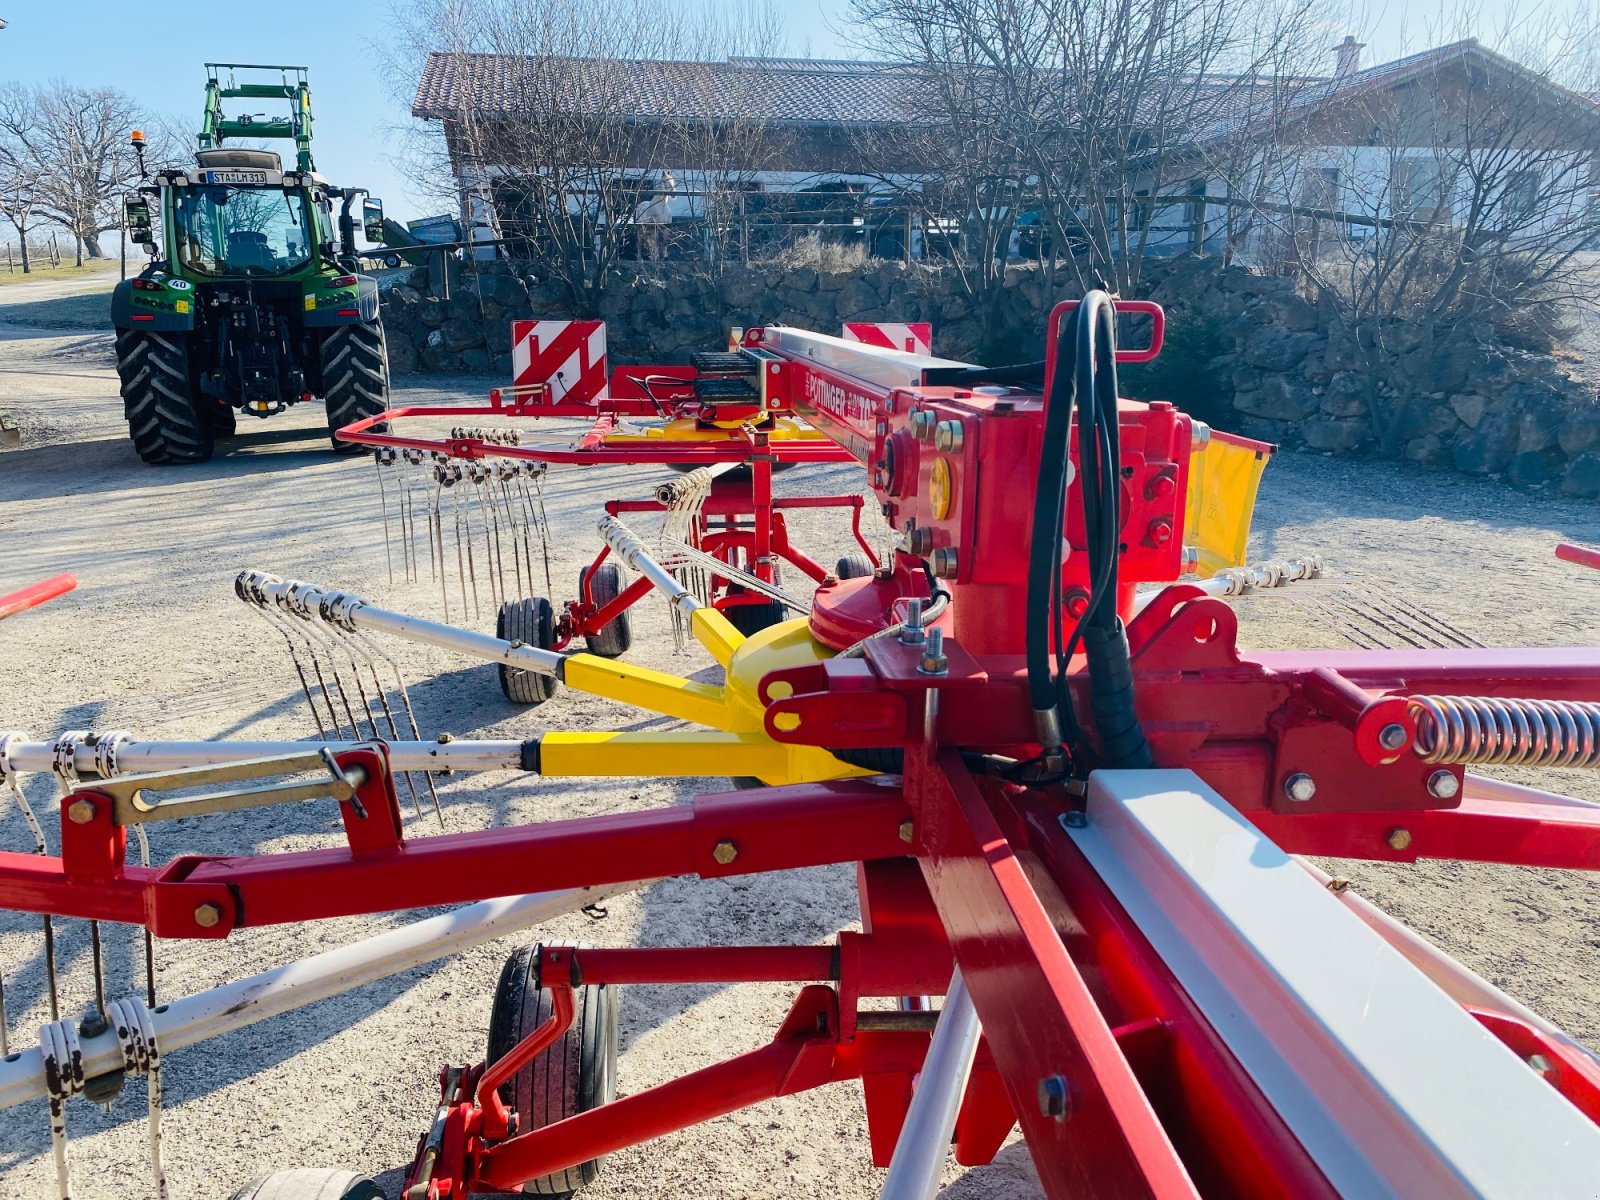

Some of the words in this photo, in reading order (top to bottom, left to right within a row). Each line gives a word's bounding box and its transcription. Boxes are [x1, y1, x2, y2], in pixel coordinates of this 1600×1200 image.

[214, 173, 231, 183] STA
[236, 173, 248, 183] LM
[250, 173, 265, 183] 313
[172, 280, 186, 289] 40
